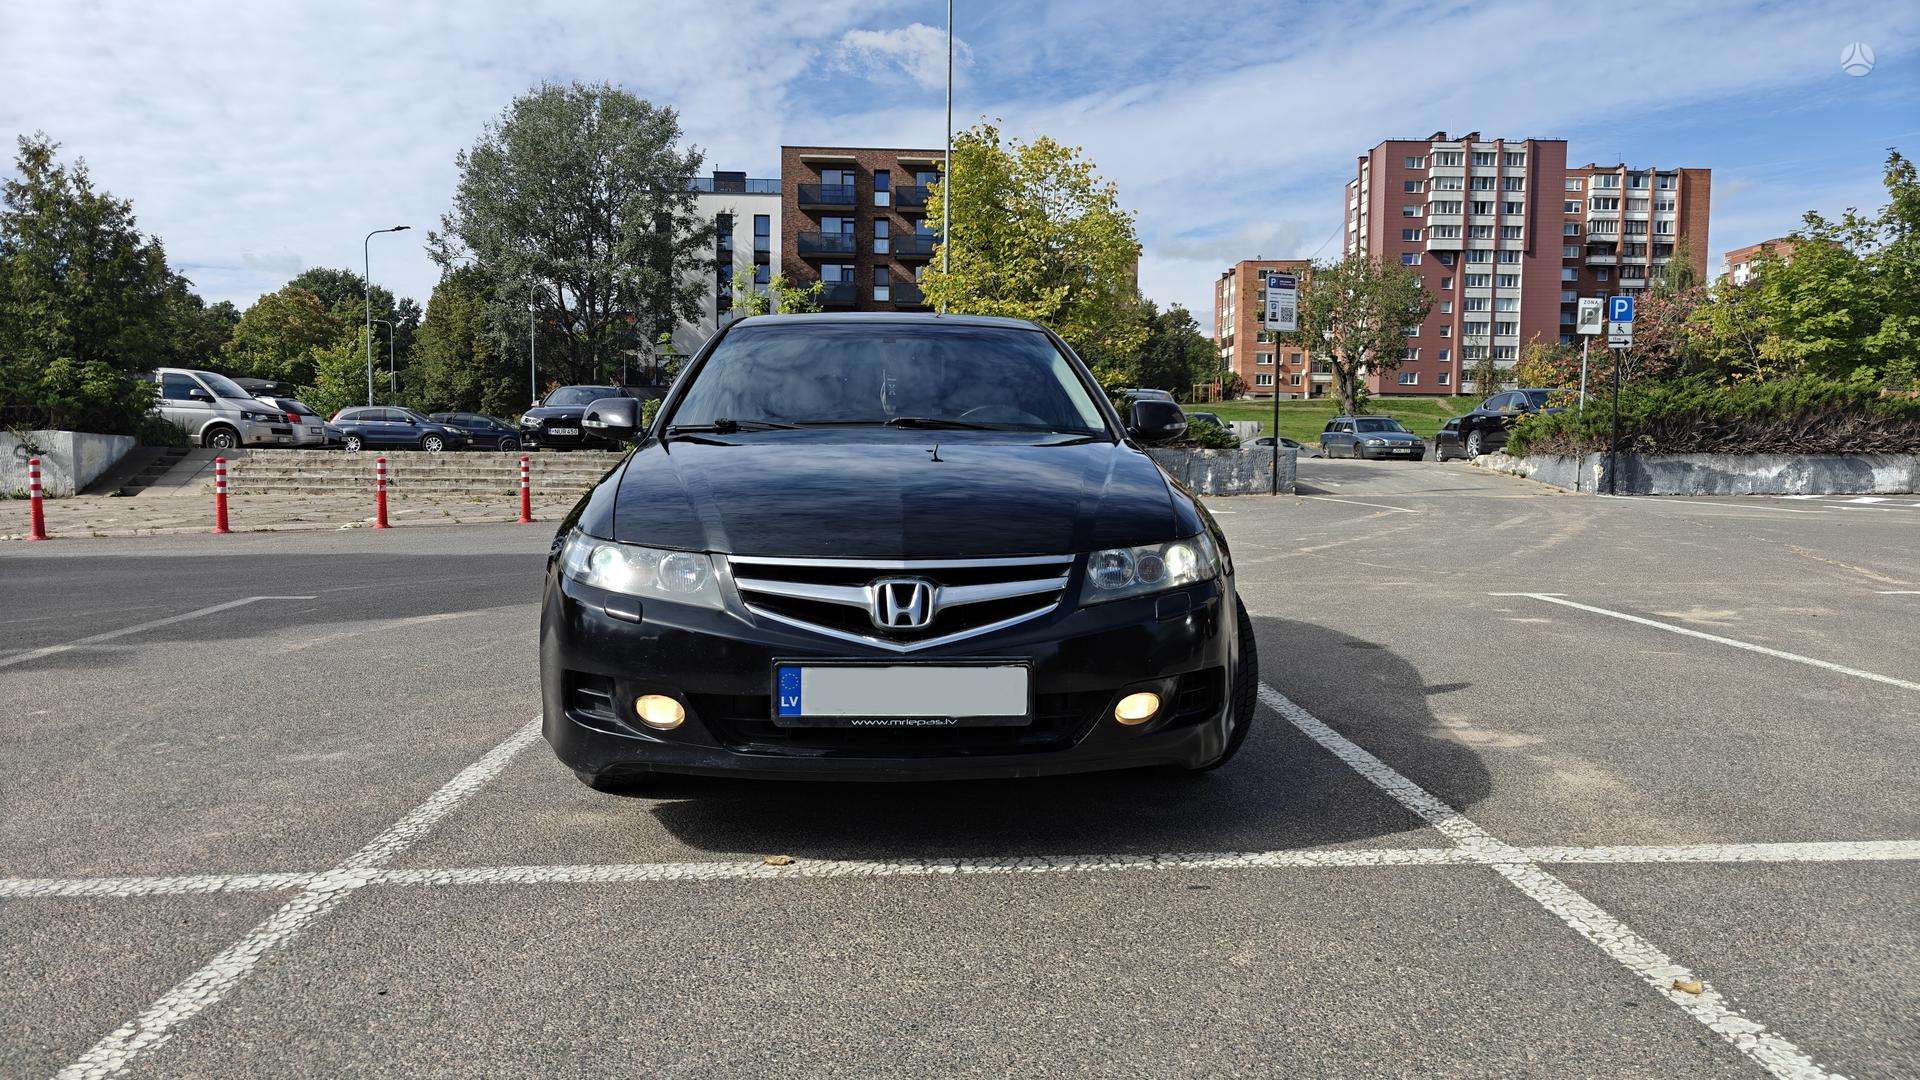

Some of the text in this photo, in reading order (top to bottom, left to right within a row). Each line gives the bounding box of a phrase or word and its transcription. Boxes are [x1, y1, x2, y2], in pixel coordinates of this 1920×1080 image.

[1270, 278, 1276, 286] P
[1585, 308, 1595, 323] P
[1615, 299, 1628, 319] P
[781, 696, 799, 707] LV
